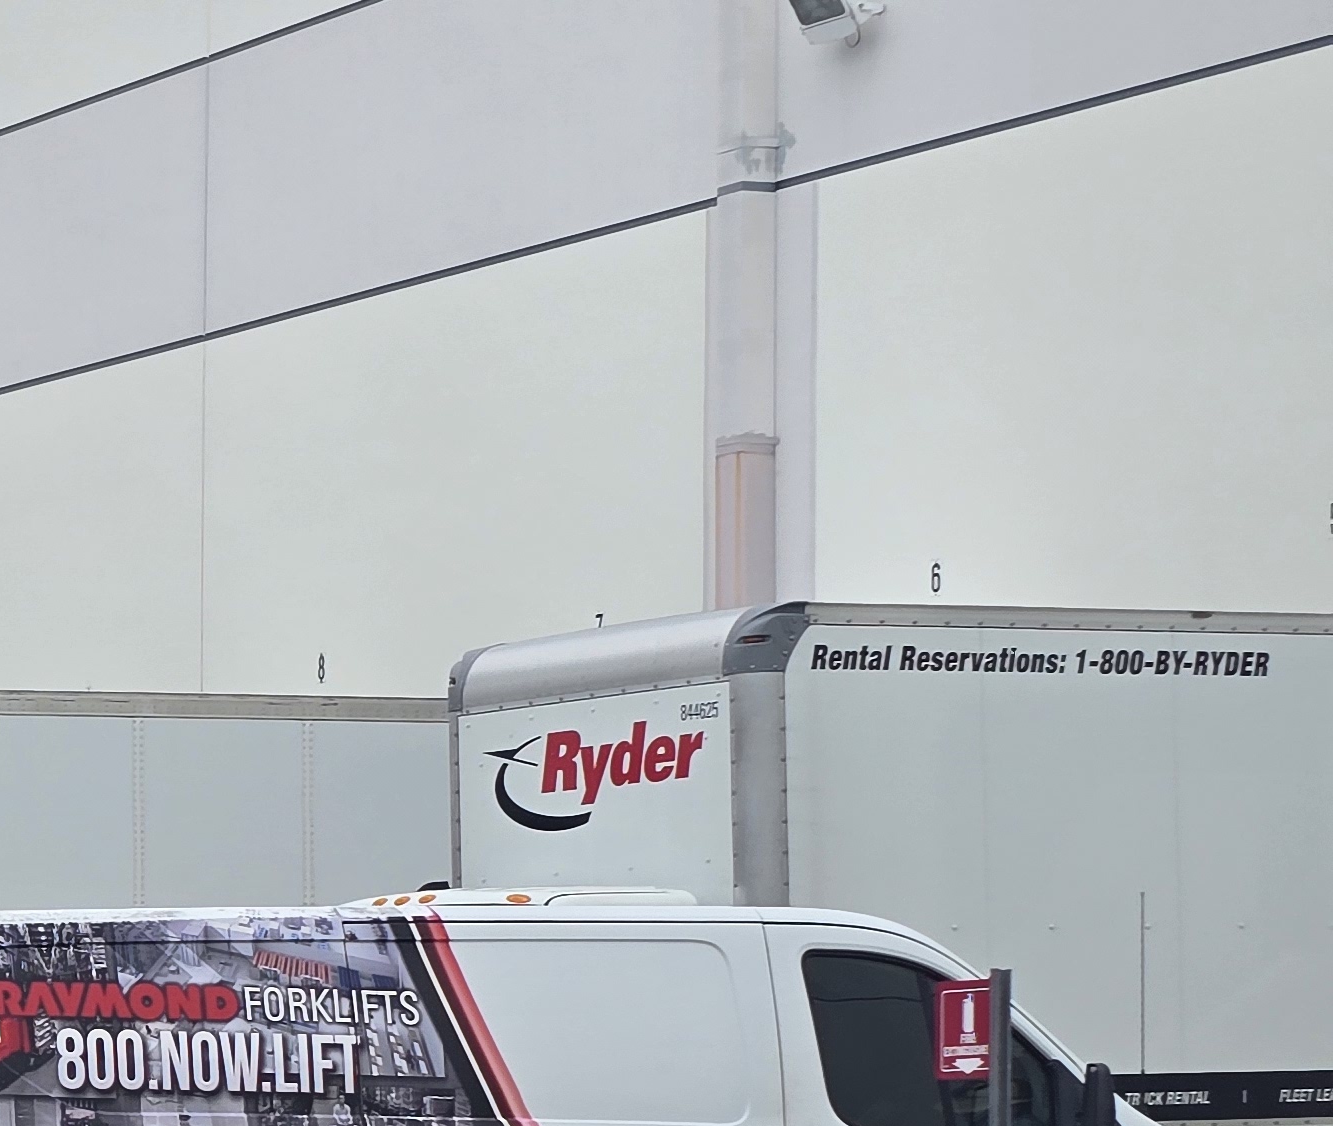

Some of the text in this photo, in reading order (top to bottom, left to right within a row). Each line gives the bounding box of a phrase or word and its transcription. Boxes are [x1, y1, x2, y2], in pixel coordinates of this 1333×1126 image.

[931, 562, 941, 593] 6
[317, 652, 326, 683] 8
[811, 644, 1271, 677] Rental Reservations: 1-800-BY-RYDER
[680, 701, 720, 721] 844625
[541, 720, 705, 805] Ryder
[244, 984, 421, 1027] FORKLIFTS
[56, 1028, 361, 1095] 800.NOW.LIFT
[1166, 1090, 1211, 1105] RENTAL
[1278, 1088, 1315, 1103] FLEET
